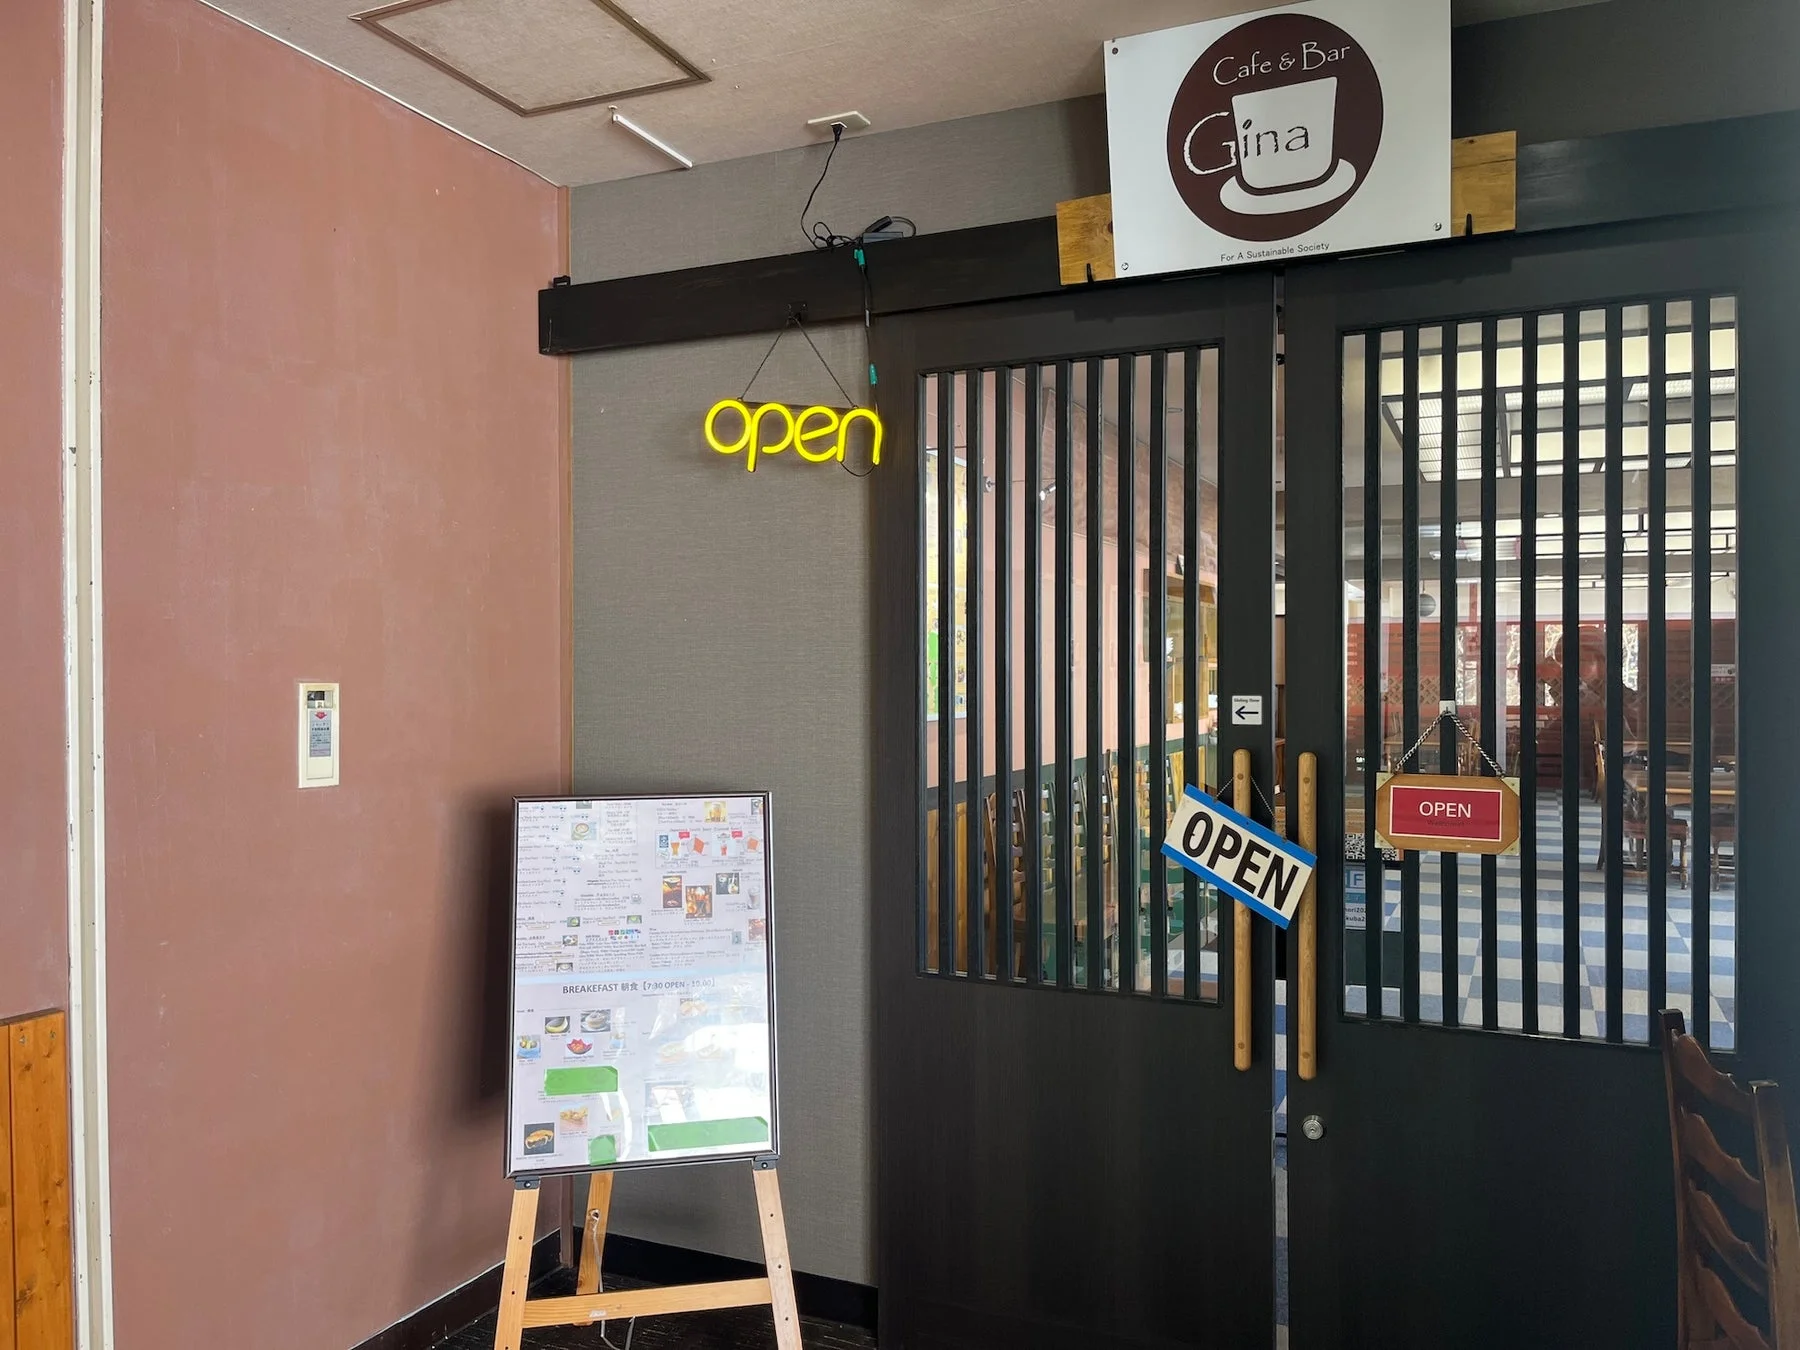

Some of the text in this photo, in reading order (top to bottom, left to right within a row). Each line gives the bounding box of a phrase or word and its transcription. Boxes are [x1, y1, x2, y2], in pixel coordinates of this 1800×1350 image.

[1212, 41, 1351, 86] Cafe & Bar
[1183, 111, 1310, 175] Gina
[1220, 242, 1330, 262] For A Sustainable Society
[704, 399, 883, 473] open
[1419, 801, 1472, 819] OPEN
[1182, 811, 1300, 911] OPEN
[562, 983, 619, 995] BREAKEFAST
[664, 981, 685, 989] OPEN
